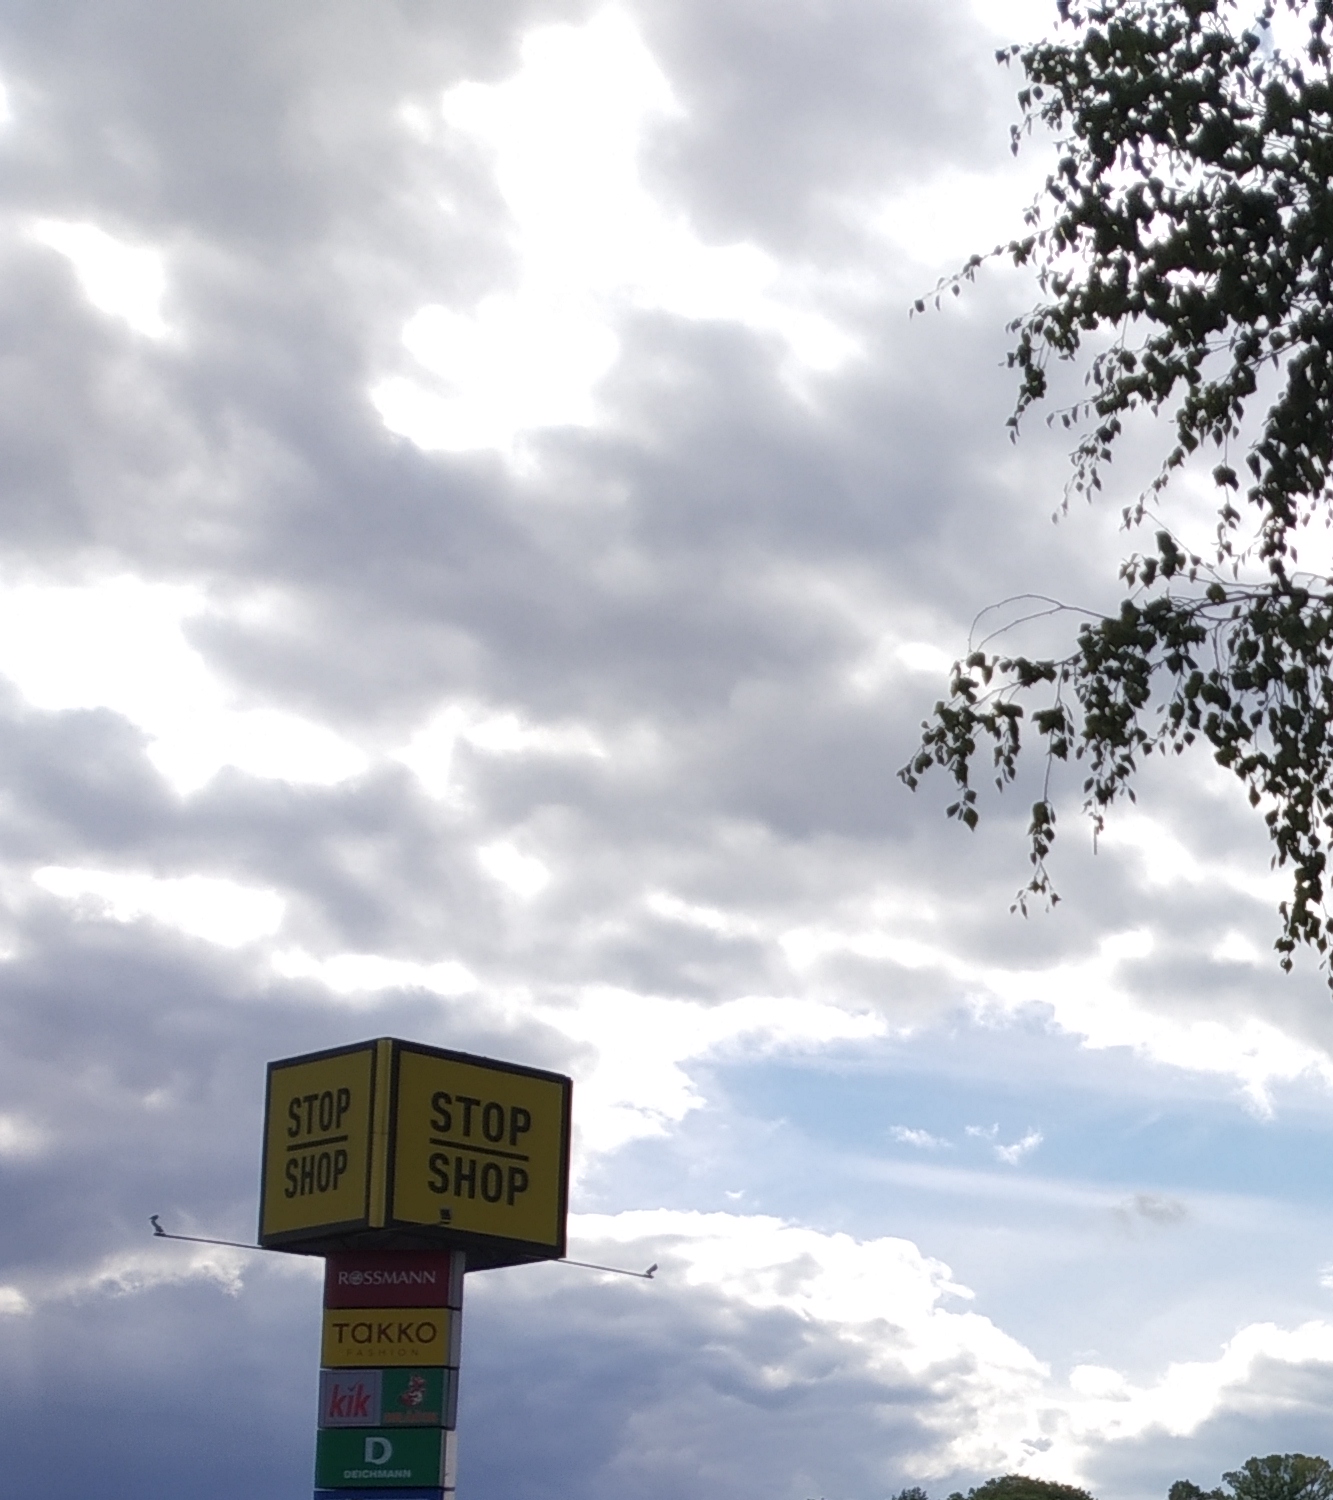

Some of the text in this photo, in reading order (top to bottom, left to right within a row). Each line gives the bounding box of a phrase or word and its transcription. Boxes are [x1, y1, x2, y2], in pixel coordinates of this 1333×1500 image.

[287, 1087, 351, 1138] STOP
[430, 1091, 532, 1146] STOP
[285, 1149, 348, 1199] SHOP
[428, 1151, 530, 1206] SHOP
[338, 1270, 436, 1286] ROSSMANN
[346, 1348, 419, 1356] FASHION
[328, 1380, 372, 1418] kik
[364, 1436, 393, 1466] D
[343, 1469, 412, 1480] DEICHMANN
